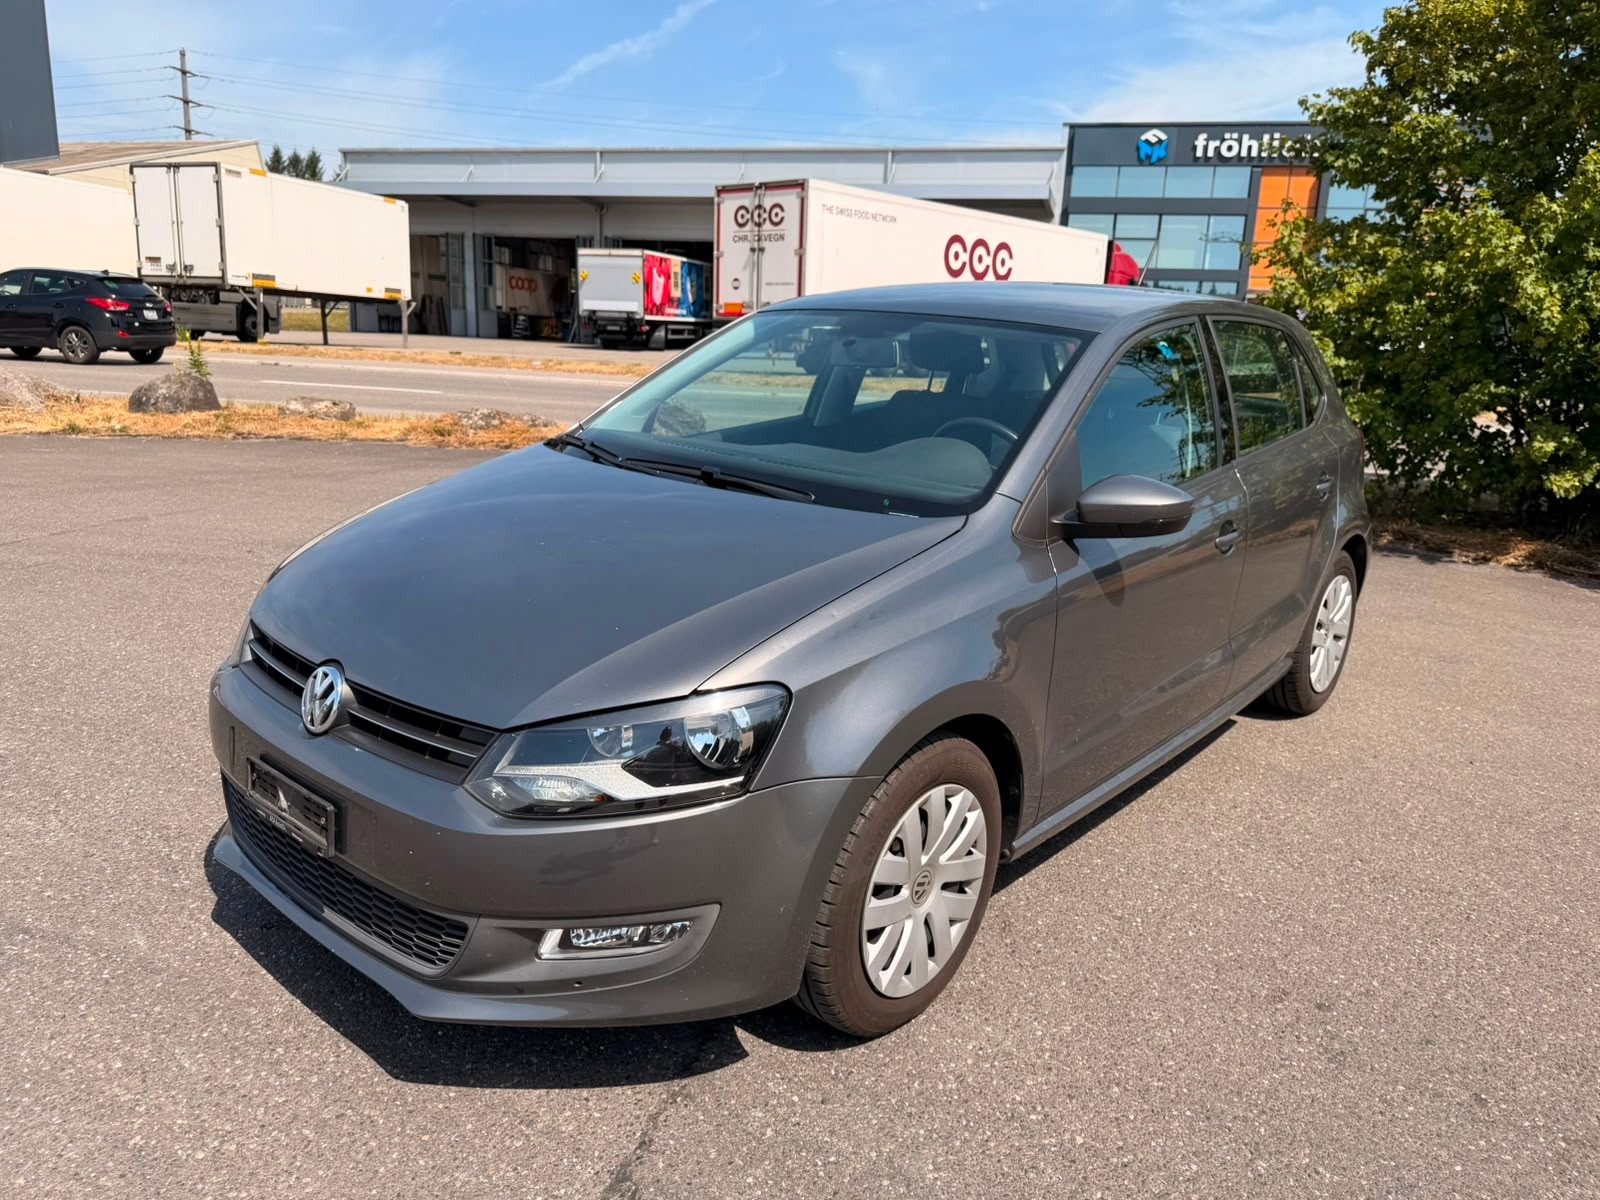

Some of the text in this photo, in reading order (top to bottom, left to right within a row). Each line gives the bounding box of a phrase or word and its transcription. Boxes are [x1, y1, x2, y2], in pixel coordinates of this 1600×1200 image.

[734, 203, 785, 228] CCC
[822, 203, 834, 215] THE
[835, 206, 853, 218] SWISS
[854, 209, 869, 220] FOOD
[944, 234, 1013, 281] CCC
